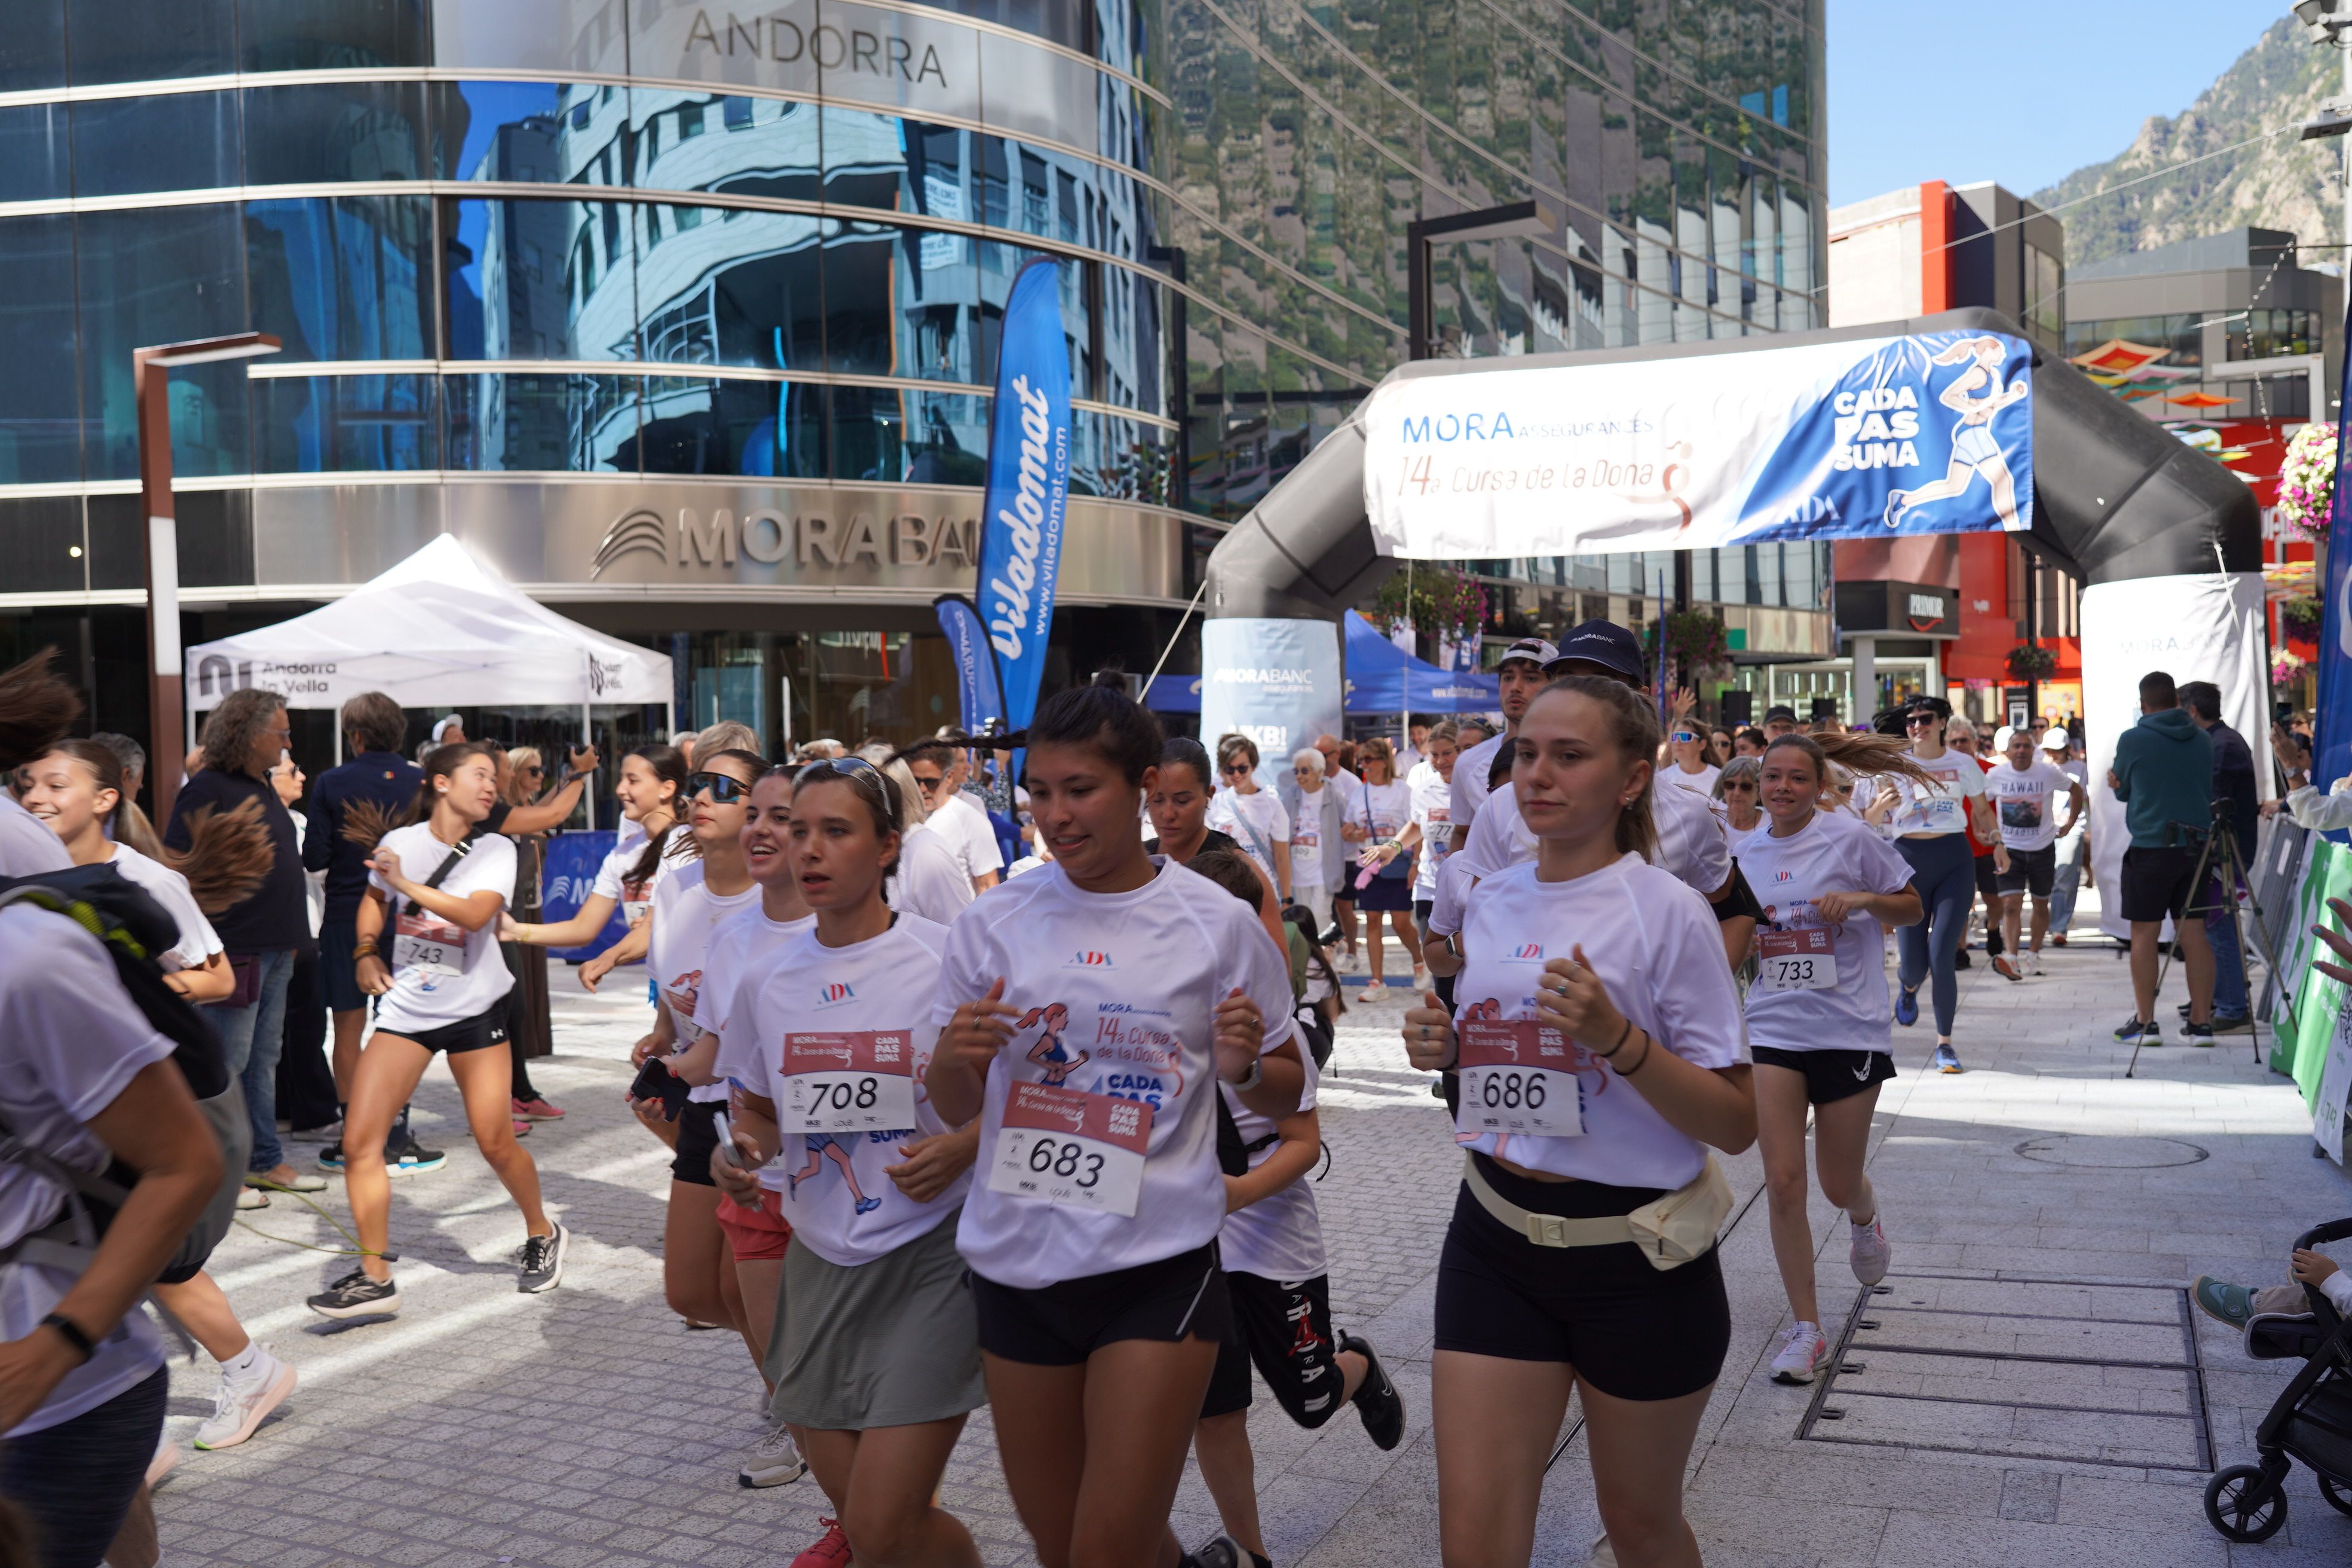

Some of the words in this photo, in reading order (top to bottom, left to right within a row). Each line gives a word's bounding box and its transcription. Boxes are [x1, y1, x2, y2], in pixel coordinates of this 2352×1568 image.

[684, 9, 947, 88] ANDORRA
[1834, 386, 1919, 415] CADA
[1403, 412, 1514, 443] MORA
[1835, 411, 1919, 444] PAS
[1834, 440, 1920, 471] SUMA
[1452, 467, 1517, 492] Cursa
[1525, 464, 1552, 489] de
[1564, 463, 1585, 489] la
[1592, 460, 1654, 488] Dona
[678, 507, 983, 569] MORABA
[1036, 427, 1067, 636] www.viladomat.com
[1577, 633, 1616, 645] MORABANC
[263, 662, 337, 674] Andorra
[1224, 668, 1313, 684] MORABANC
[284, 679, 329, 692] Vella
[2002, 782, 2043, 794] HAWAII
[1773, 870, 1793, 882] ADA
[409, 943, 443, 964] 743
[1068, 951, 1113, 966] ADA
[1778, 960, 1813, 981] 733
[818, 982, 856, 1004] ADA
[1098, 1003, 1132, 1013] MORA
[1128, 1027, 1170, 1046] Cursa
[1539, 1036, 1563, 1046] PAS
[875, 1045, 900, 1054] PAS
[1097, 1047, 1113, 1058] de
[1118, 1047, 1132, 1060] la
[1133, 1048, 1165, 1063] Dona
[1108, 1074, 1163, 1092] CADA
[1484, 1072, 1547, 1110] 686
[810, 1077, 877, 1115] 708
[1111, 1104, 1140, 1116] CADA
[1110, 1114, 1139, 1126] PAS
[1108, 1123, 1137, 1137] SUMA
[1030, 1138, 1105, 1188] 683
